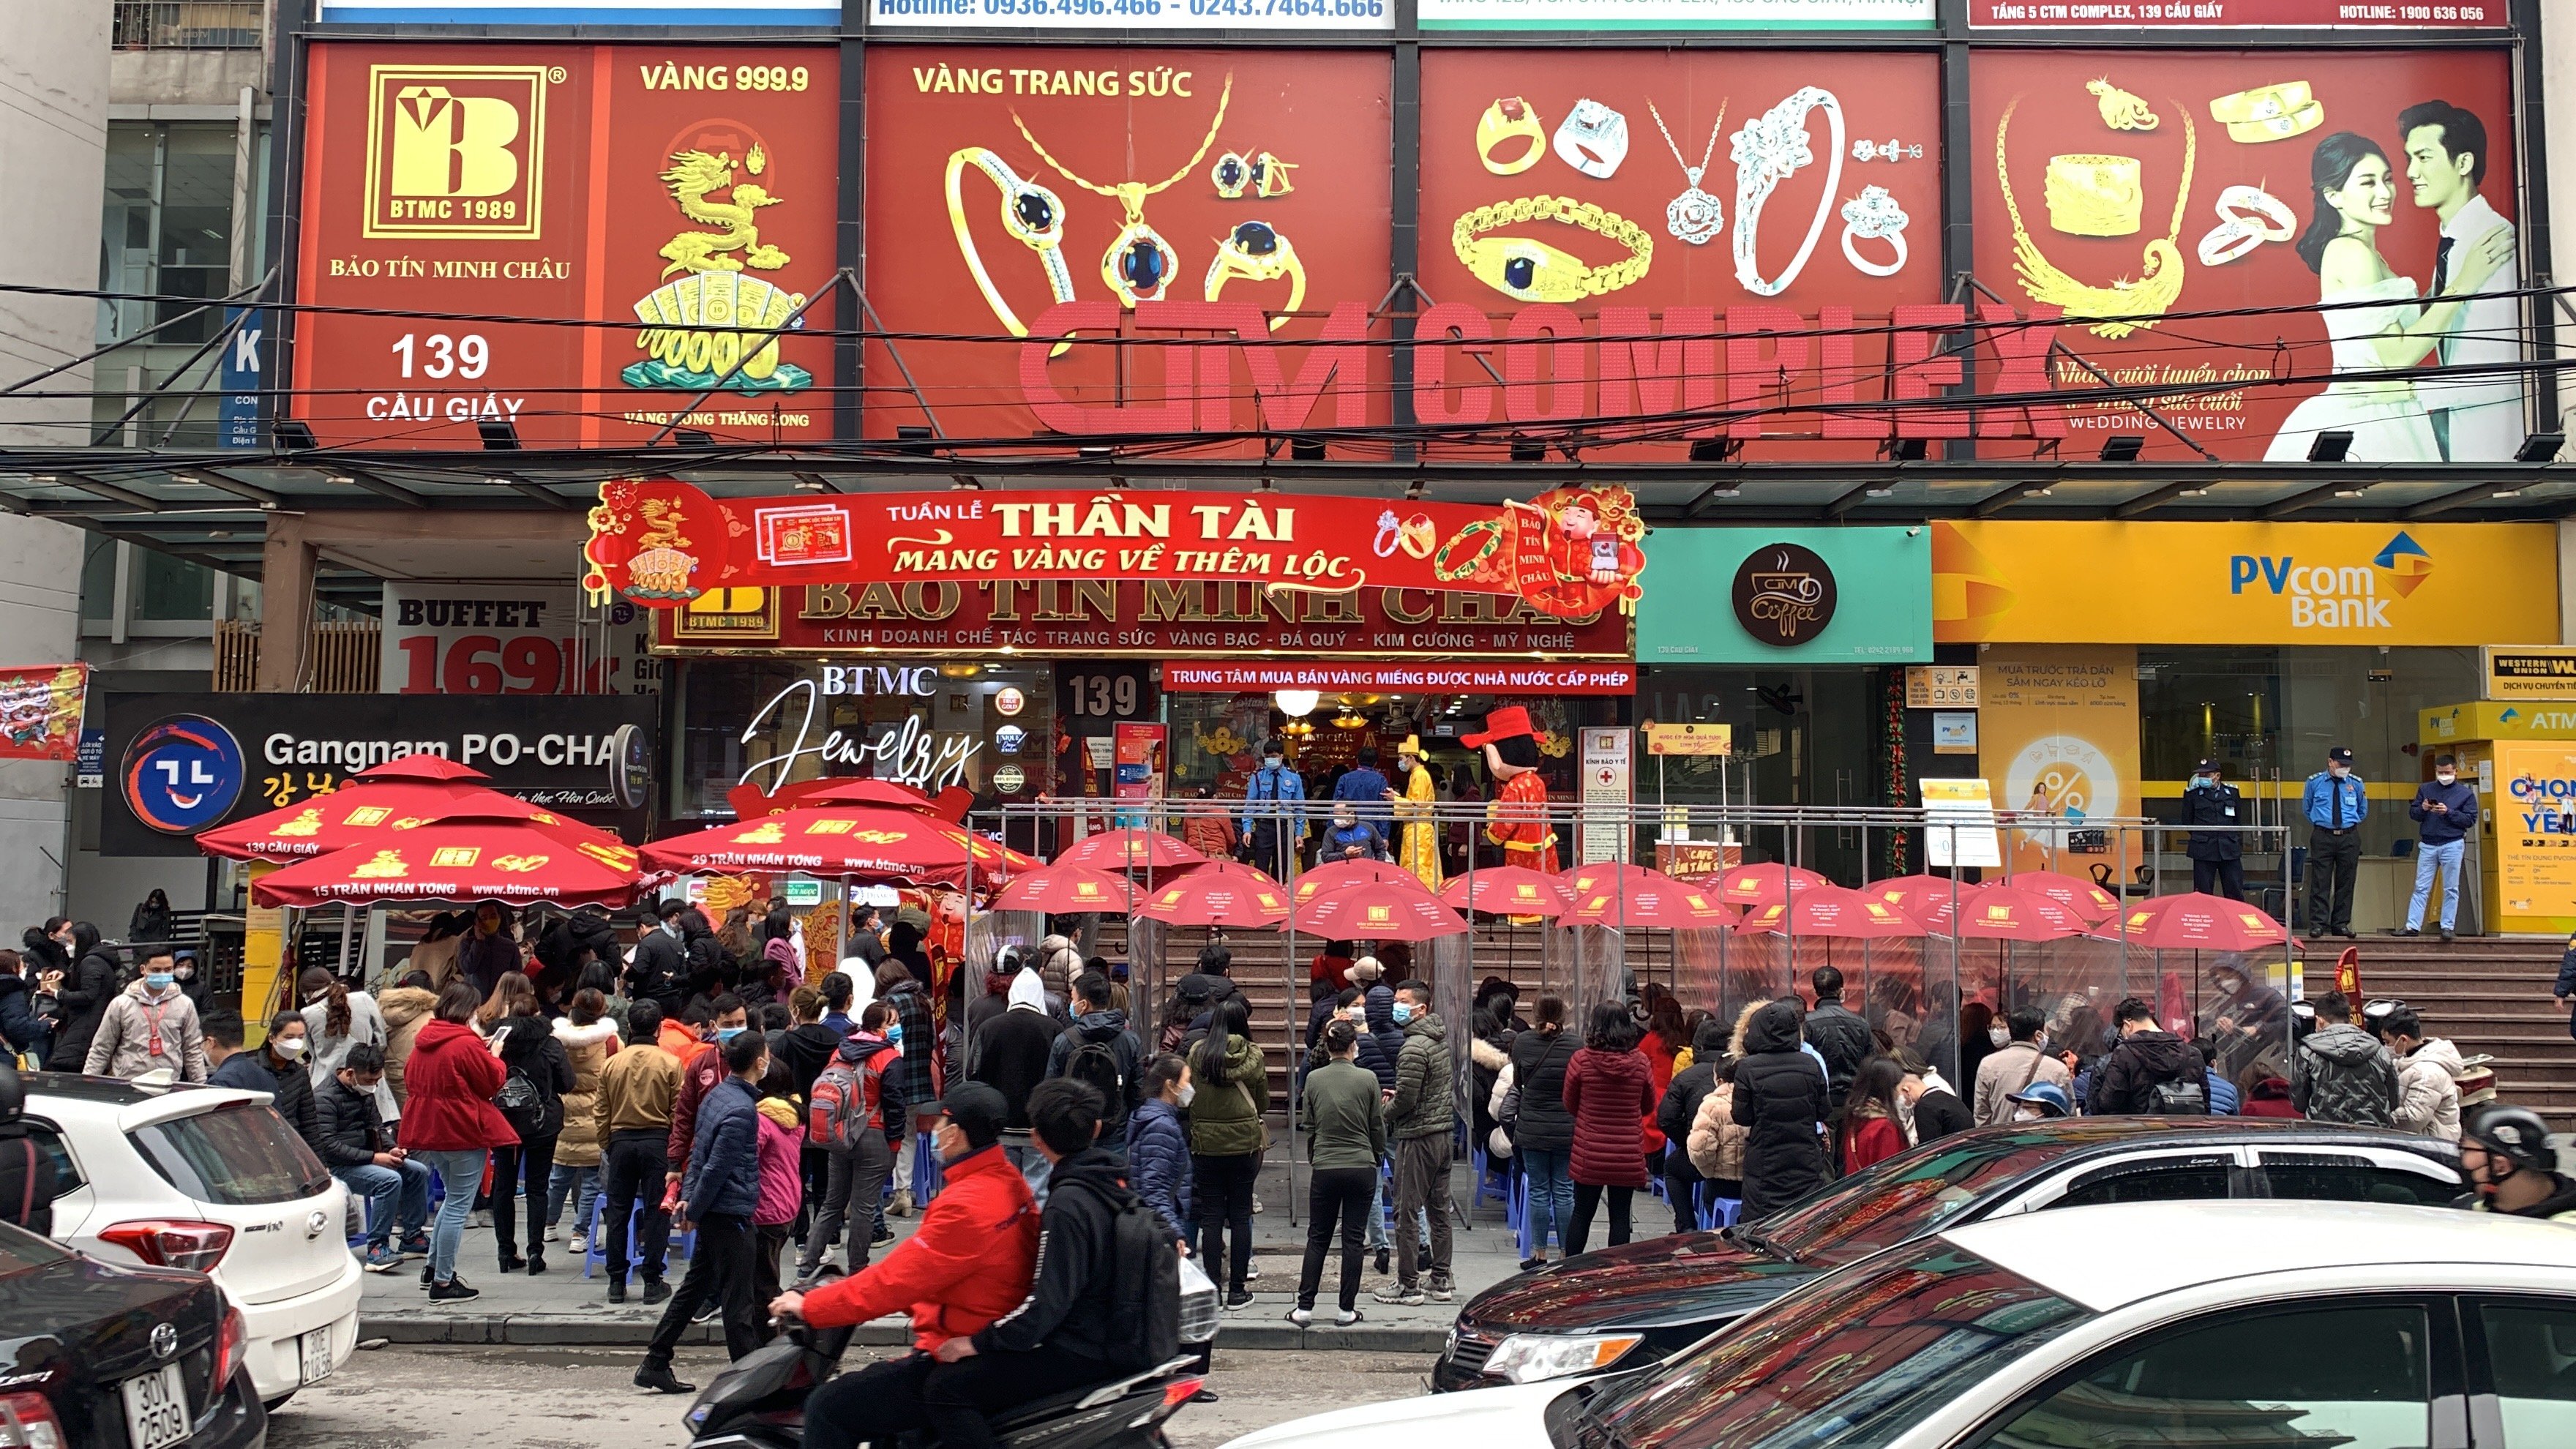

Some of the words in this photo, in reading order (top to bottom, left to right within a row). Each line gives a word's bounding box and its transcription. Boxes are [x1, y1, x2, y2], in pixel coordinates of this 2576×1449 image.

[2029, 7, 2034, 18] 5
[2040, 5, 2067, 19] CTM
[2071, 5, 2135, 20] COMPLEX,
[2138, 5, 2161, 18] 139
[2340, 5, 2396, 19] HOTLINE:
[2400, 6, 2430, 20] 1900
[2433, 7, 2457, 20] 636
[2460, 7, 2485, 20] 056
[640, 60, 727, 90] VÀNG
[735, 66, 809, 91] 999.9
[913, 63, 1003, 94] VÀNG
[1009, 70, 1120, 96] TRANG
[1128, 66, 1192, 98] SỨC
[390, 200, 452, 219] BTMC
[462, 201, 516, 220] 1989
[329, 255, 379, 277] BẢO
[385, 256, 426, 278] TÍN
[432, 261, 498, 279] MINH
[503, 257, 570, 280] CHÂU
[236, 329, 261, 372] K
[392, 334, 489, 379] 139
[1413, 303, 2066, 441] COMPLEX
[366, 392, 434, 422] CẦU
[445, 395, 525, 423] GIẤY
[719, 411, 768, 426] THĂNG
[2070, 416, 2159, 430] WEDDING
[886, 500, 951, 522] TUẦN
[956, 498, 982, 520] LỄ
[990, 493, 1170, 538] THẦN
[1189, 499, 1295, 542] TÀI
[1521, 517, 1540, 531] BẢO
[893, 547, 999, 572] MANG
[1012, 540, 1109, 572] VÀNG
[1119, 543, 1165, 572] VỀ
[1174, 546, 1272, 576] THÊM
[1276, 548, 1352, 580] LỘC
[1519, 555, 1546, 566] MINH
[1521, 570, 1551, 585] CHÂU
[2231, 555, 2375, 596] PVcom
[397, 599, 546, 628] BUFFET
[689, 616, 727, 628] BTMC
[733, 617, 764, 629] 1989
[1751, 600, 1823, 637] Coffee
[2291, 596, 2392, 628] Bank
[824, 629, 873, 643] KINH
[882, 629, 948, 643] DOANH
[955, 626, 992, 644] CHẾ
[1002, 626, 1037, 645] TÁC
[1046, 631, 1111, 646] TRANG
[1117, 628, 1156, 647] SỨC
[1169, 629, 1217, 648] VÀNG
[1225, 631, 1261, 650] BẠC
[1280, 629, 1303, 648] ĐÁ
[1310, 629, 1347, 649] QUÝ
[1374, 632, 1404, 648] KIM
[1411, 631, 1475, 648] CƯƠNG
[1526, 630, 1576, 651] NGHỆ
[2498, 659, 2547, 667] WESTERN
[2513, 667, 2547, 675] UNION
[821, 666, 938, 697] BTMC
[1171, 670, 1222, 684] TRUNG
[1224, 667, 1257, 684] TÂM
[1259, 671, 1295, 685] MUA
[1298, 667, 1328, 685] BÁN
[1331, 667, 1373, 686] VÀNG
[1376, 667, 1424, 686] MIẾNG
[1426, 671, 1471, 689] ĐƯỢC
[1474, 669, 1506, 686] NHÀ
[1510, 669, 1554, 686] NƯỚC
[1557, 668, 1587, 687] CẤP
[1590, 669, 1629, 688] PHÉP
[2033, 678, 2063, 687] NGAY
[2504, 683, 2522, 692] DỊCH
[1069, 675, 1137, 716] 139
[739, 679, 984, 798] Jewelry
[264, 733, 449, 774] Gangnam
[462, 733, 613, 765] PO-CHA
[245, 842, 266, 853] 139
[1690, 850, 1713, 861] CAFE
[692, 854, 708, 866] 29
[844, 857, 925, 875] www.btmc.vn
[312, 886, 329, 897] 15
[472, 883, 559, 897] www.btmc.vn
[266, 1221, 284, 1233] i10
[137, 1374, 171, 1411] 30V
[138, 1404, 183, 1448] 2509
